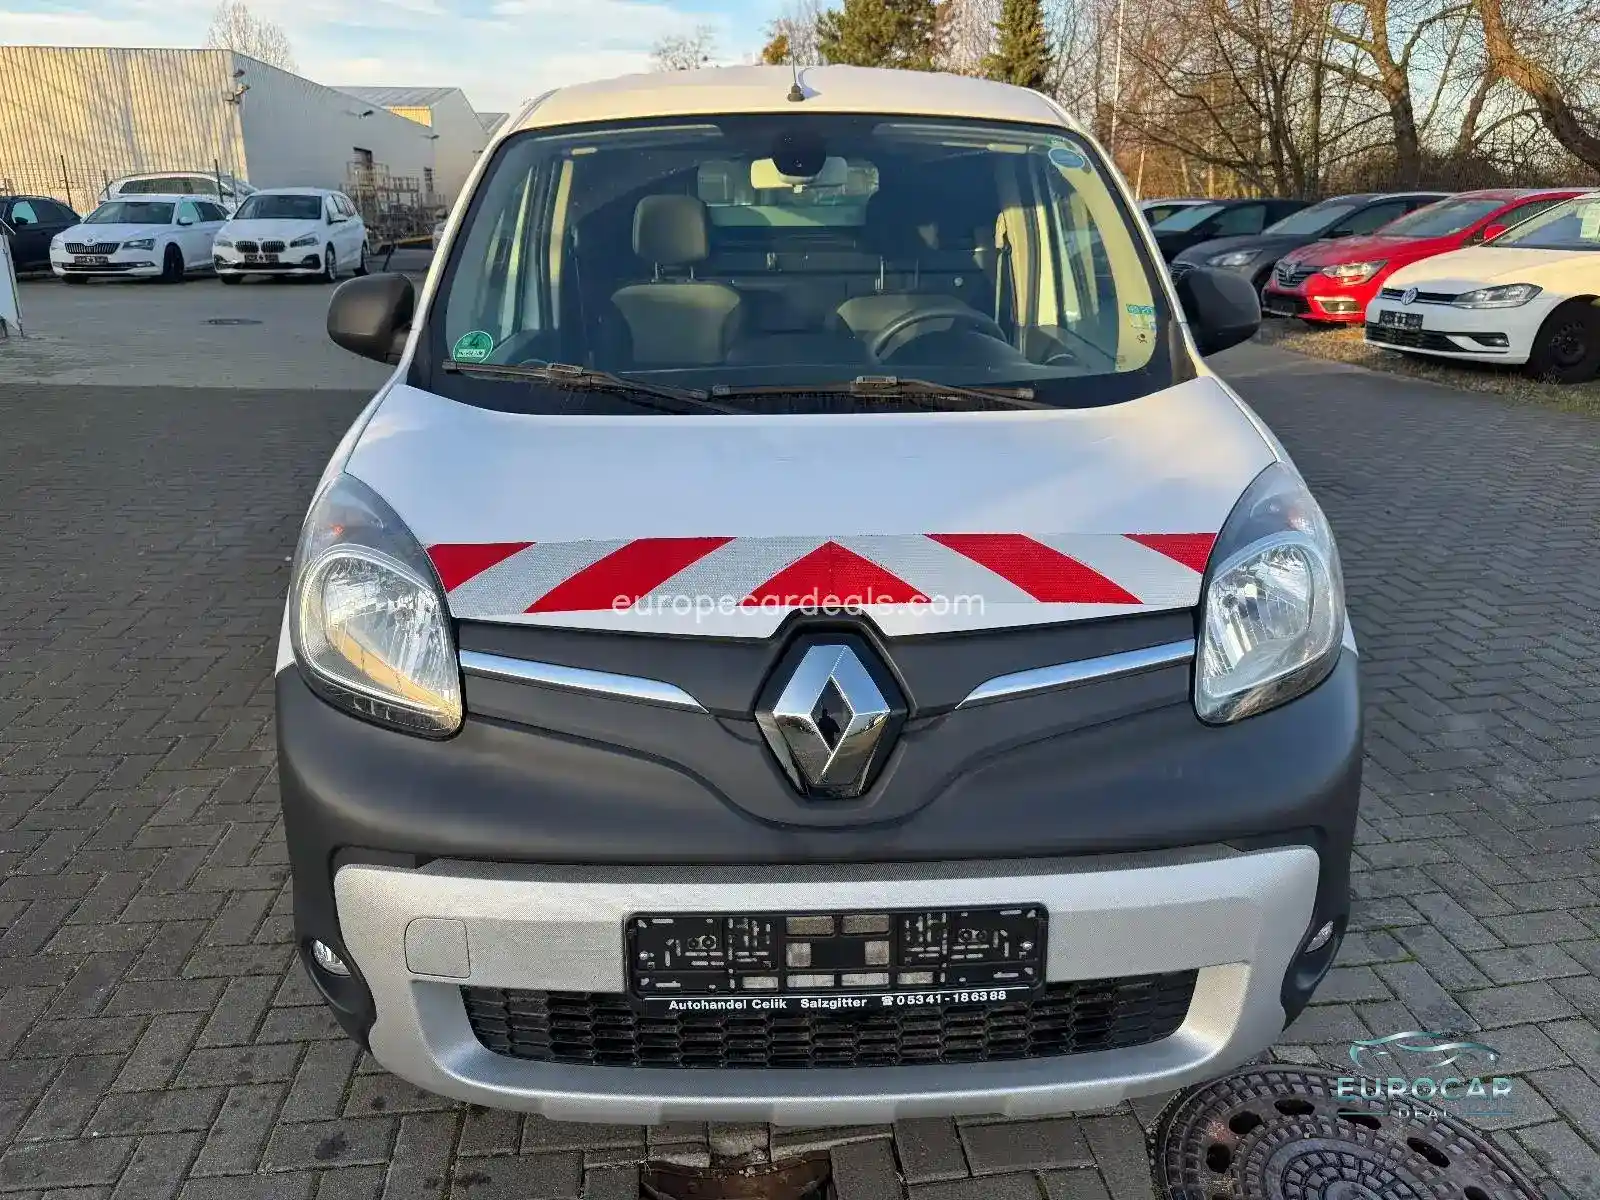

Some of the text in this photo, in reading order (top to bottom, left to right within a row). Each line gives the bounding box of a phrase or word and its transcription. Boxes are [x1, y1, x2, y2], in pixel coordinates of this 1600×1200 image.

[668, 1000, 747, 1010] Autohandel
[751, 999, 787, 1009] Celik
[800, 998, 867, 1009] Salzgitter
